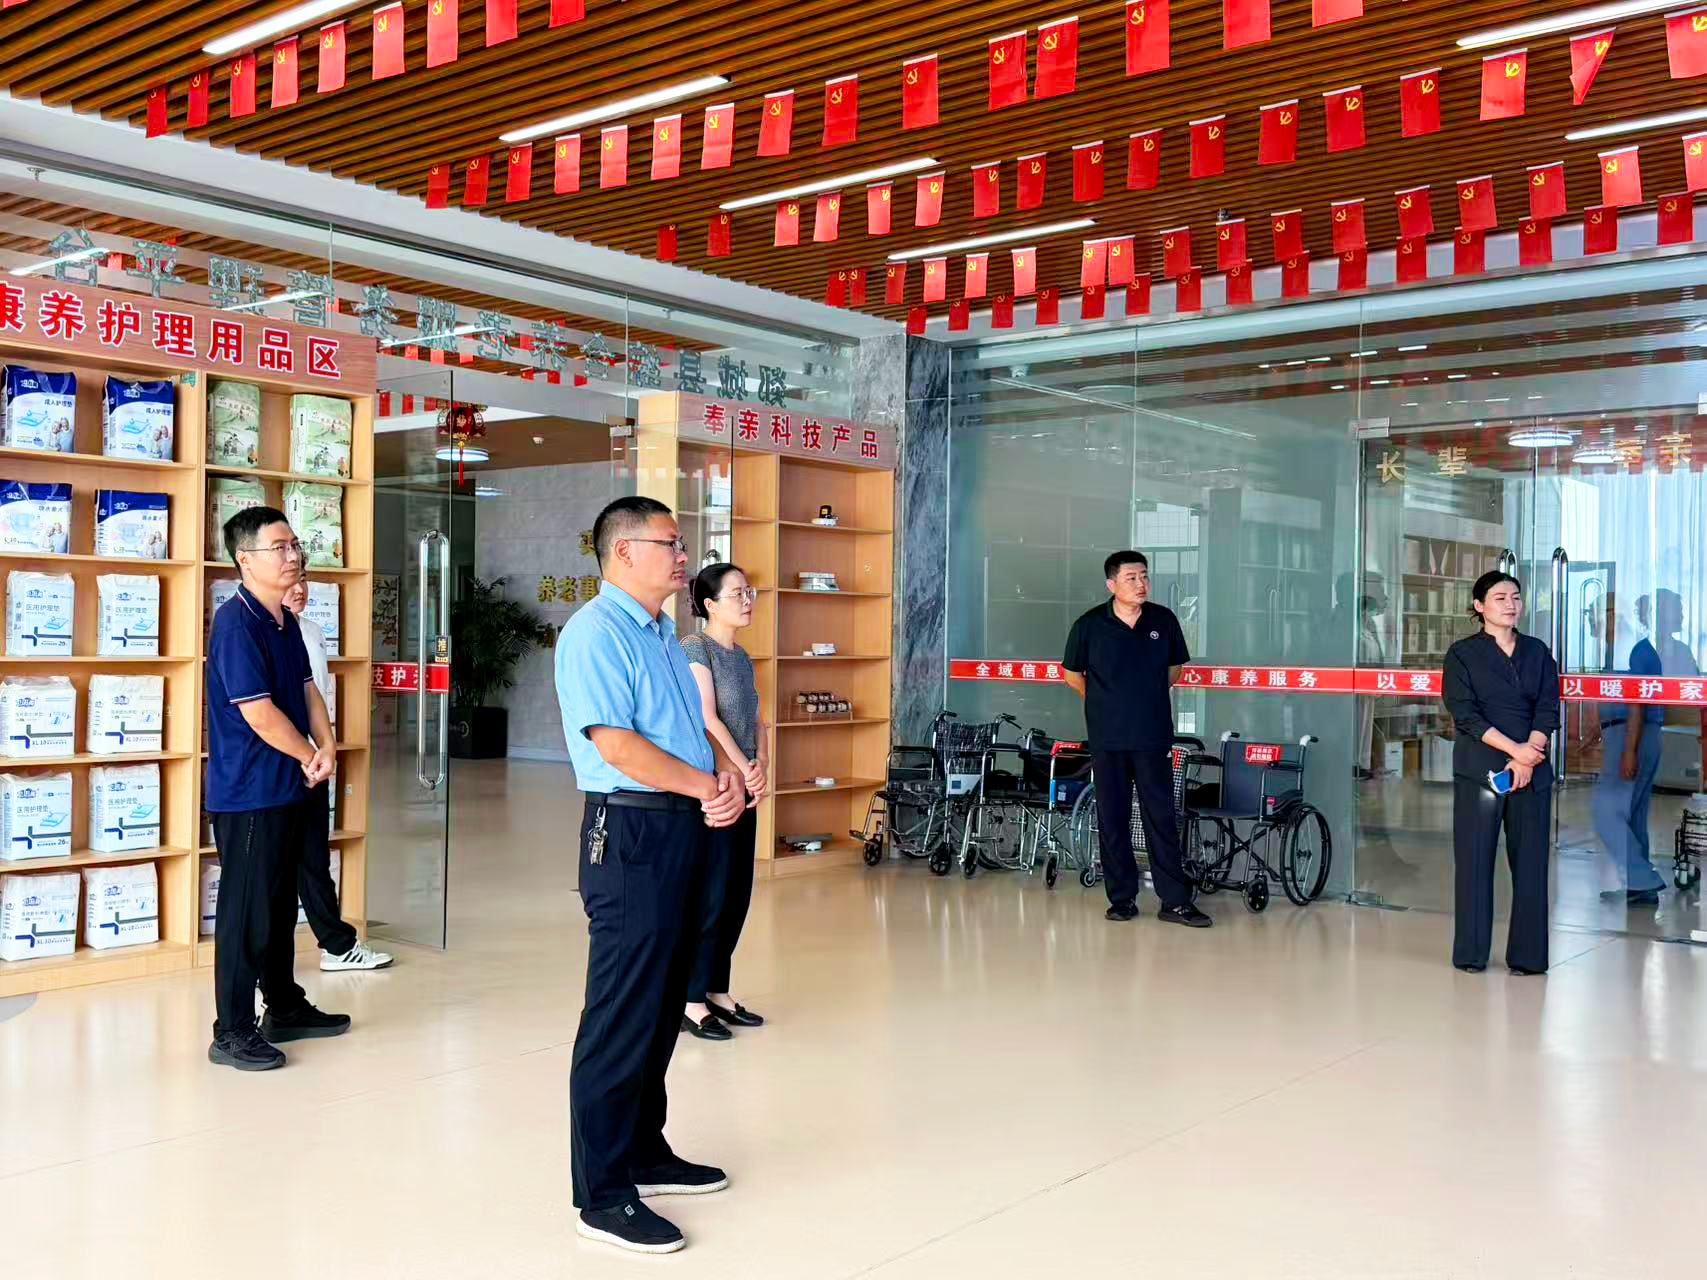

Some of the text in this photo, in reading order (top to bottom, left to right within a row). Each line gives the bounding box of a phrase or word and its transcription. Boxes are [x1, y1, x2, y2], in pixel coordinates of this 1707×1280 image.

[703, 404, 879, 459] 奉亲科技产品
[975, 662, 1704, 700] 全域信息 心康养服务 以爱 以暖护家
